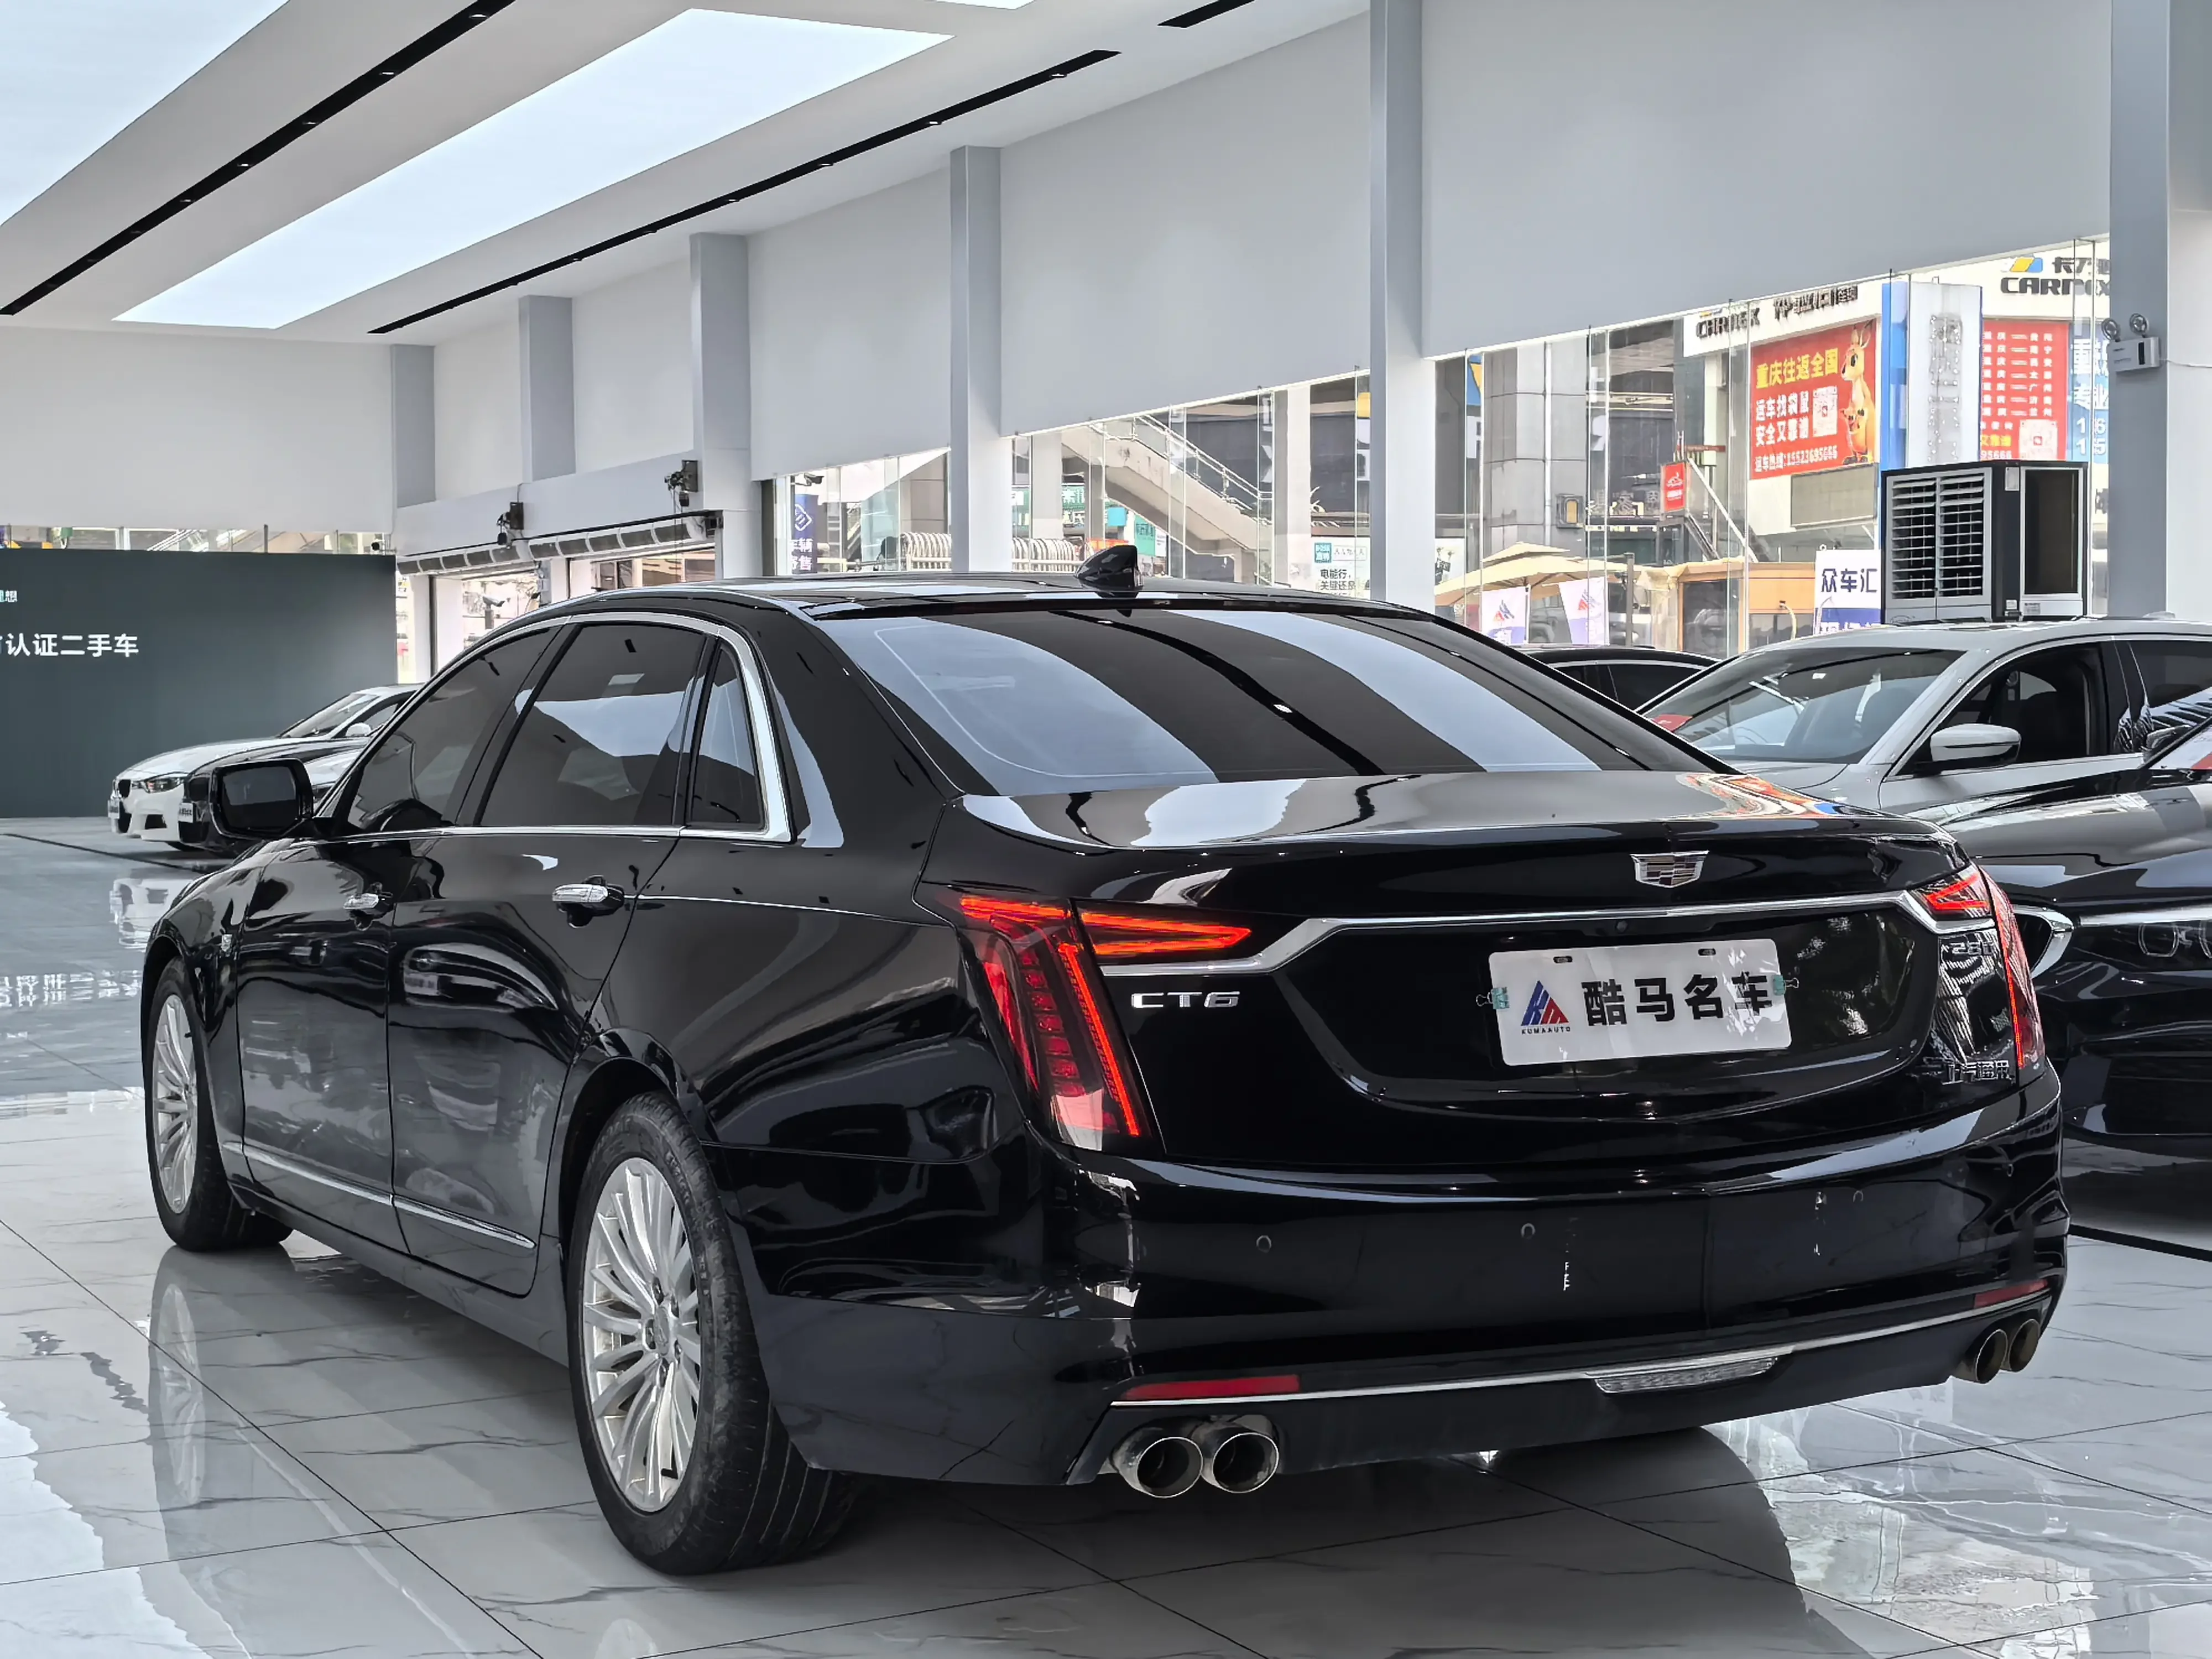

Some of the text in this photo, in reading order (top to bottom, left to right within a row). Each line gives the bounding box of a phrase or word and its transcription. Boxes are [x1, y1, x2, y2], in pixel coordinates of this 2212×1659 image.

[1756, 347, 1839, 389] 重庆往返全国
[1820, 568, 1878, 593] 众车汇
[0, 633, 139, 658] 认证二手车
[1131, 991, 1240, 1009] CT6
[1580, 971, 1773, 1026] 酷马名车
[1521, 1026, 1571, 1035] KUMAAUTO
